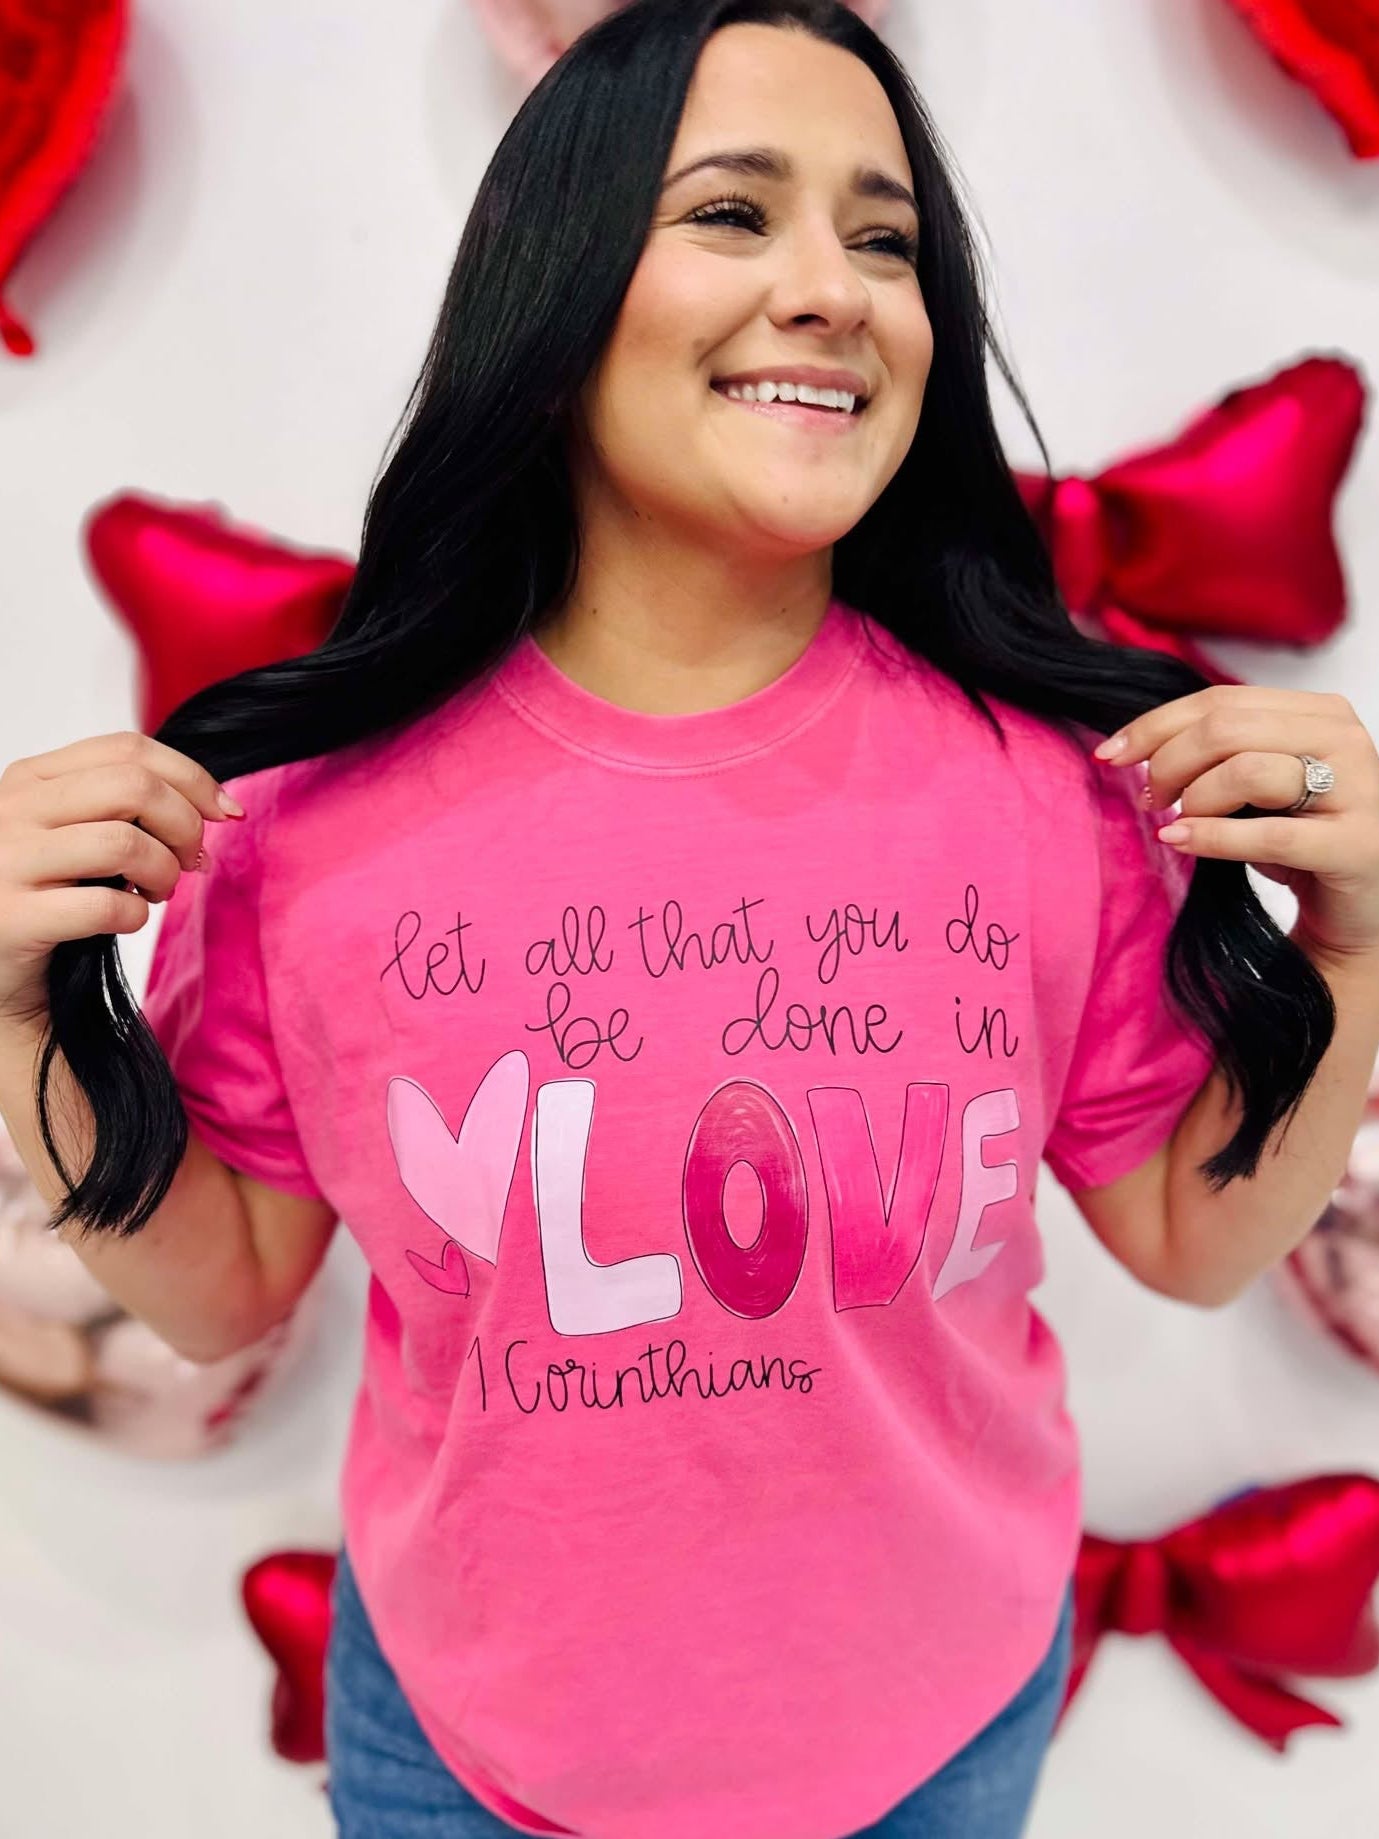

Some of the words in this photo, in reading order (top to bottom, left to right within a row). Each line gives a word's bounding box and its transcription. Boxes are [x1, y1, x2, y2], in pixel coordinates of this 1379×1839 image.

[380, 910, 486, 1000] let
[525, 905, 614, 976] all
[627, 896, 774, 978] that
[805, 903, 909, 985] you
[945, 883, 1020, 970] do
[524, 981, 644, 1070] be
[721, 966, 903, 1056] done
[954, 996, 1019, 1059] in
[533, 1077, 1022, 1338] LOVE
[465, 1336, 488, 1412] 1
[504, 1339, 823, 1415] Corinthians
